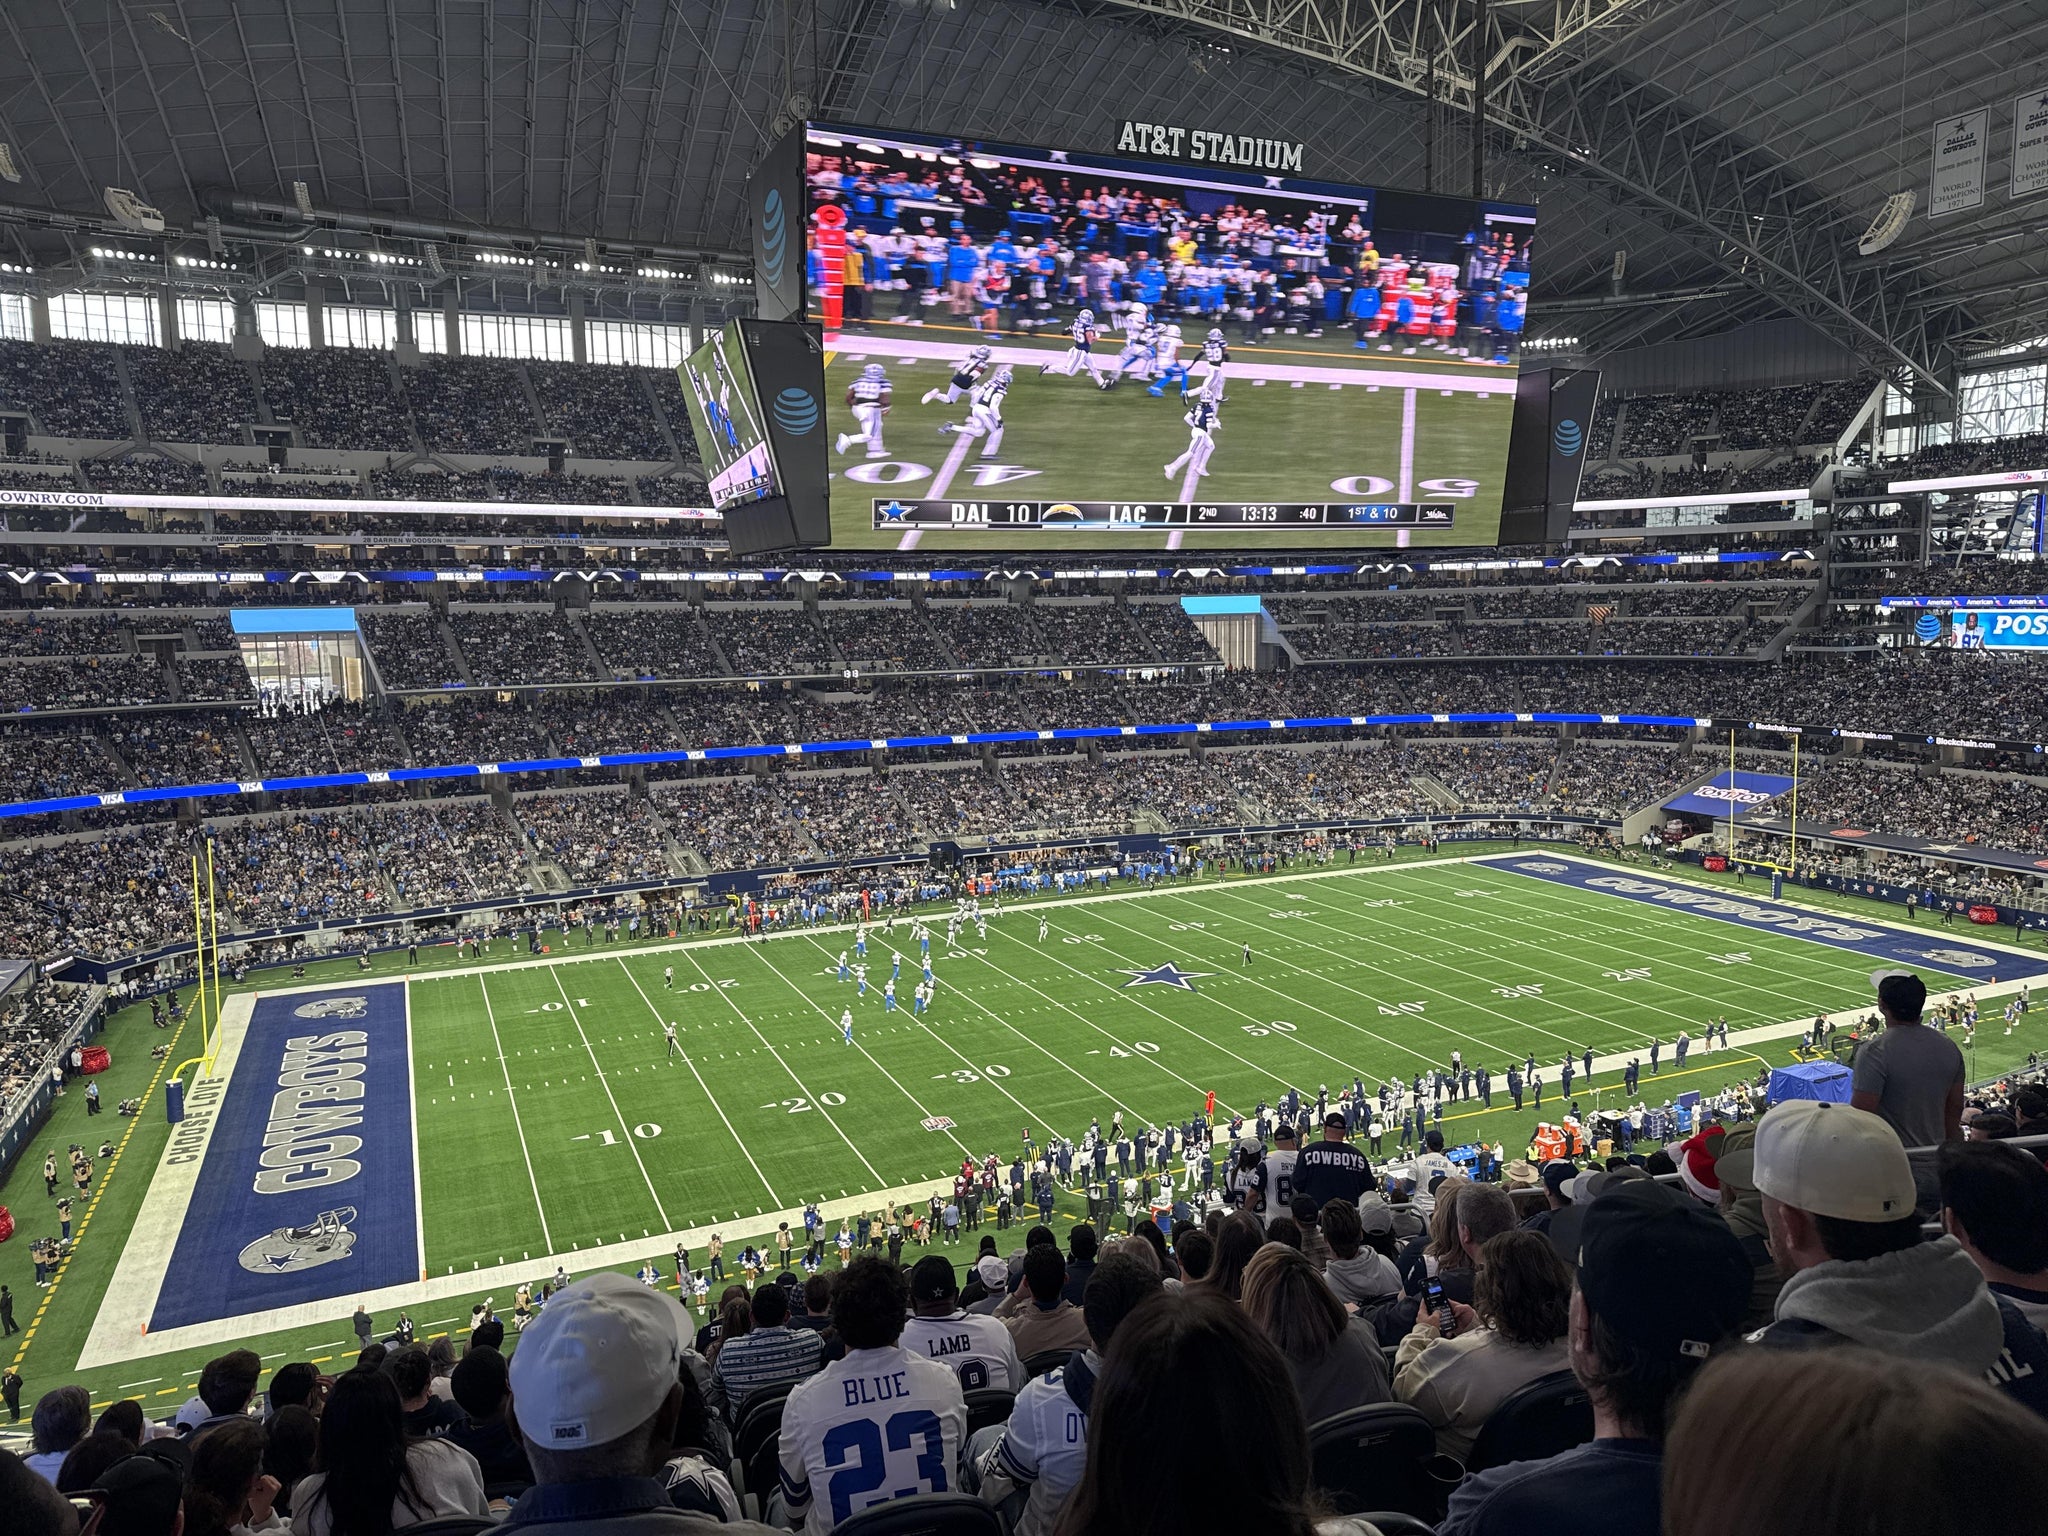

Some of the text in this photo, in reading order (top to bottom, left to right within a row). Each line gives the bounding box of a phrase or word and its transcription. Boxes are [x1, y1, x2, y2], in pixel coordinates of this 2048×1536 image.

[1117, 121, 1304, 171] AT&T STADIUM
[1946, 132, 1975, 146] DALLAS
[1942, 139, 1978, 155] COWBOYS
[1942, 180, 1972, 193] WORLD
[1948, 199, 1965, 209] 1971
[951, 503, 992, 523] DAL
[1006, 504, 1030, 523] 10
[1109, 505, 1147, 523] LAC
[1163, 506, 1172, 523] 7
[1198, 507, 1218, 521] 2ND
[1240, 507, 1278, 521] 13:13
[1299, 508, 1317, 521] :40
[1348, 507, 1367, 519] 1ST
[1369, 508, 1379, 519] &
[1380, 508, 1398, 520] 10
[95, 573, 114, 582] FIFA
[117, 573, 147, 582] WORLD
[170, 573, 216, 582] ARGENTINA
[229, 573, 264, 582] AUSTRIA
[436, 572, 453, 581] JUNE
[1993, 615, 2048, 635] POS
[1962, 634, 1980, 648] 97
[1601, 715, 1619, 723] VISA
[1695, 718, 1711, 727] VISA
[1038, 731, 1053, 739] VISA
[1755, 723, 1802, 733] Blockchain.com
[1840, 729, 1893, 741] Blockchain.com
[784, 745, 802, 753] VISA
[871, 740, 887, 748] VISA
[1936, 736, 1996, 749] Blockchain.com
[580, 758, 600, 766] VISA
[686, 751, 705, 759] VISA
[477, 765, 499, 773] VISA
[366, 773, 389, 782] VISA
[238, 782, 263, 792] VISA
[98, 793, 125, 804] VISA
[1585, 876, 1887, 941] COWBOYS
[1062, 934, 1105, 945] 50
[1602, 967, 1648, 982] 20
[1491, 983, 1541, 999] 30
[1377, 1001, 1425, 1017] 40
[1241, 1020, 1298, 1038] 50
[1109, 1041, 1161, 1059] 40
[951, 1064, 1012, 1084] 30
[188, 1077, 225, 1109] LOVE
[782, 1092, 847, 1114] 20
[253, 1030, 368, 1194] COWBOYS
[166, 1109, 214, 1166] CHOOSE
[595, 1122, 663, 1147] 10
[1552, 1145, 1561, 1155] G
[1304, 1150, 1366, 1170] COWBOYS
[1424, 1160, 1442, 1168] JAMES
[928, 1334, 971, 1358] LAMB
[842, 1371, 910, 1407] BLUE
[822, 1409, 948, 1527] 23
